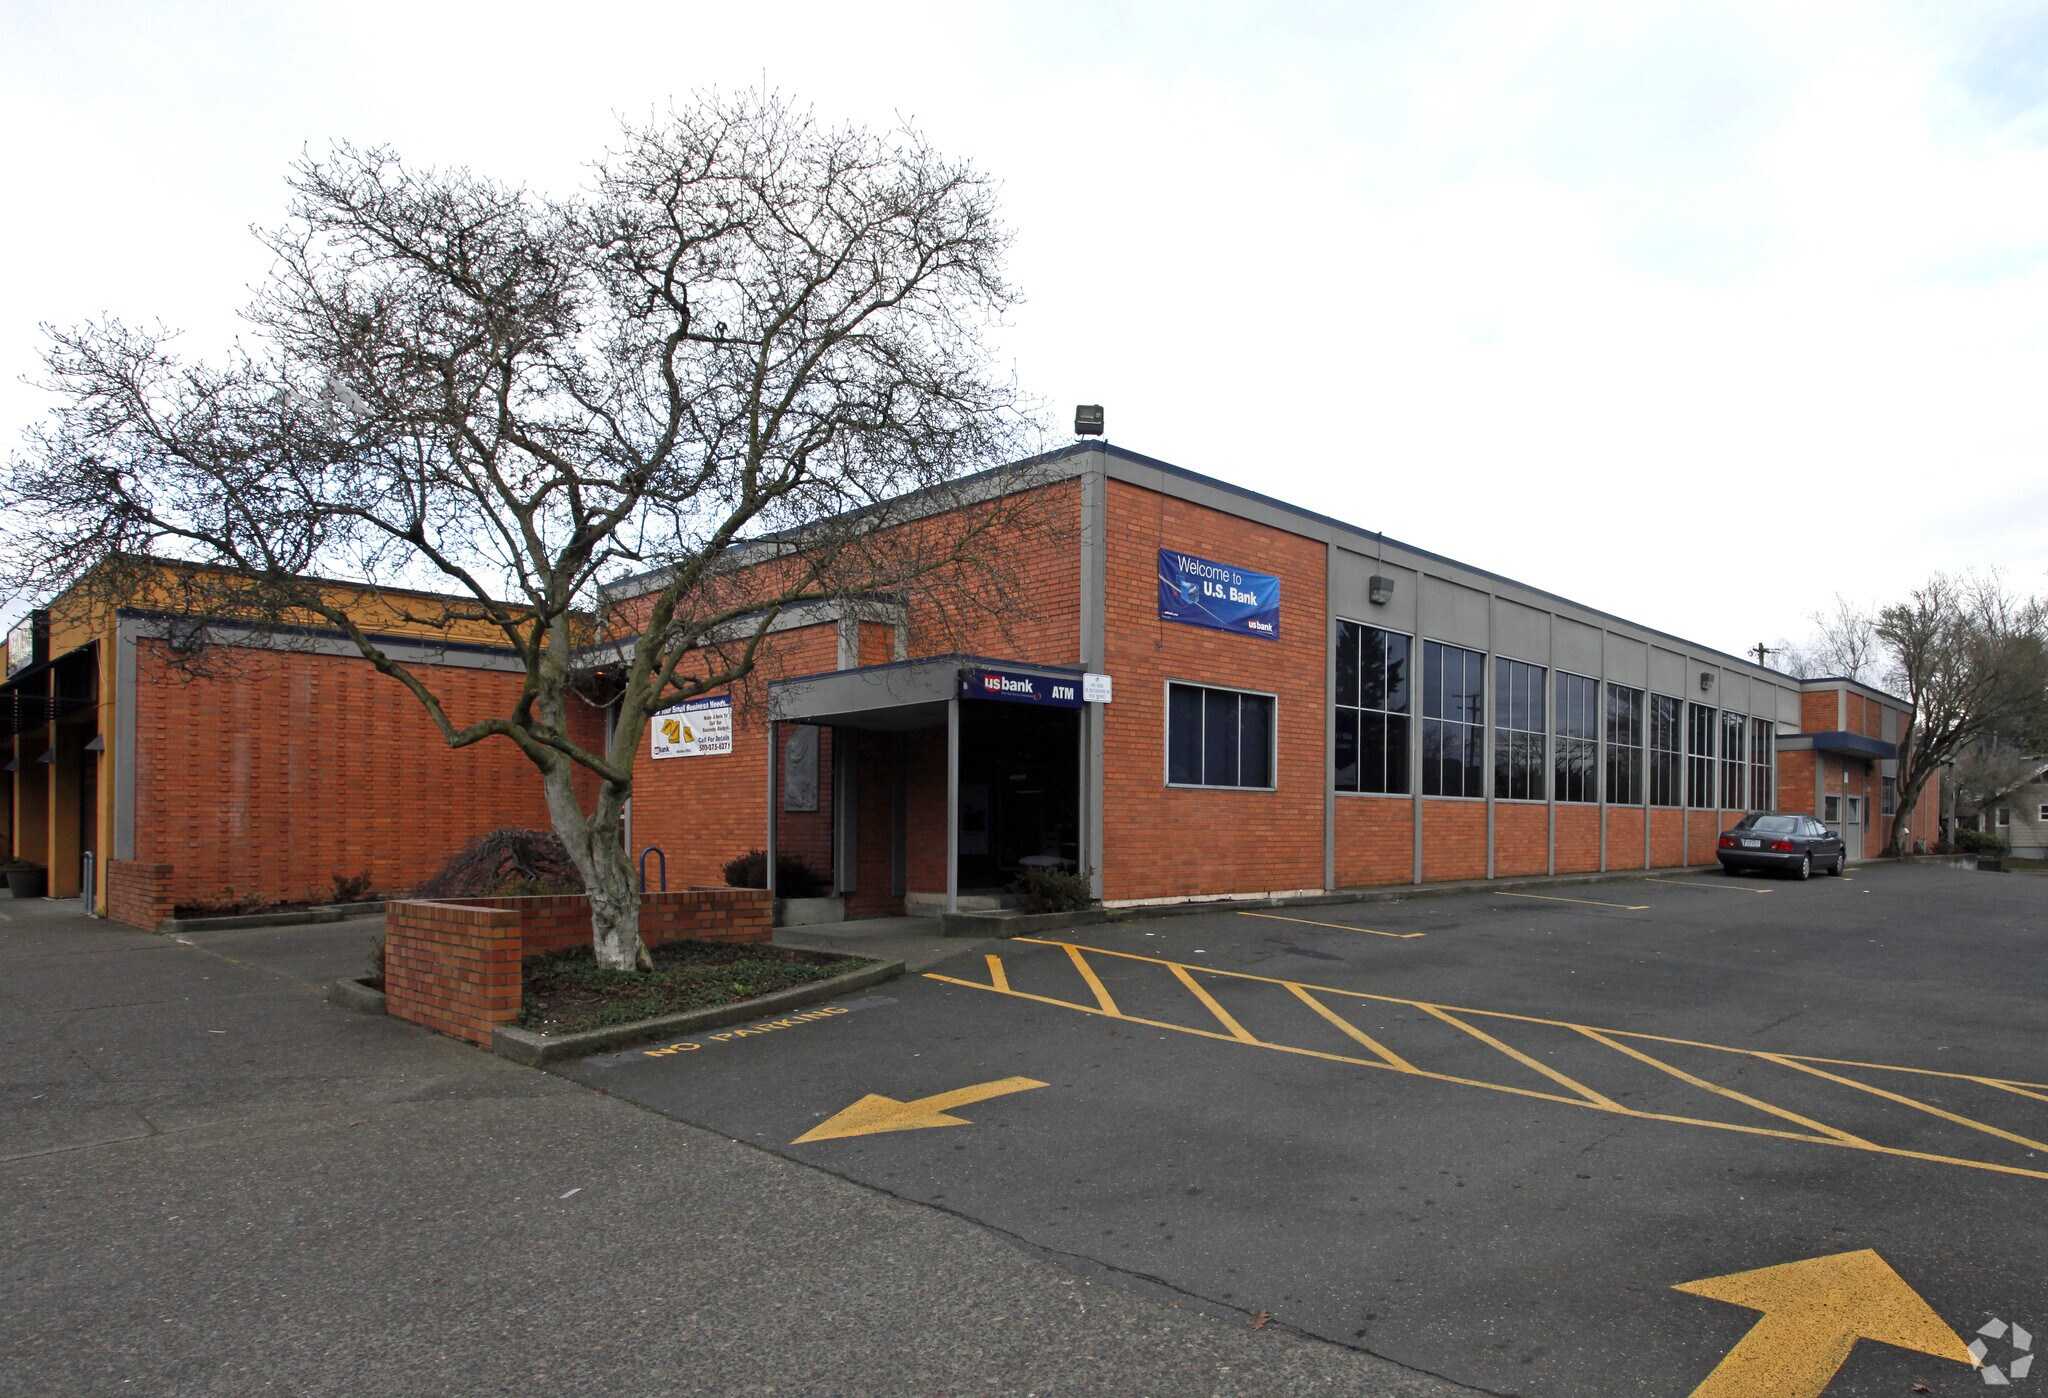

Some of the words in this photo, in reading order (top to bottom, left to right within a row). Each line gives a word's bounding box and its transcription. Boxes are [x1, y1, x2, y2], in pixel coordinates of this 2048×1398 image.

[1177, 555, 1230, 583] Welcome
[1232, 571, 1242, 586] to
[1203, 581, 1227, 600] U.S.
[1229, 586, 1258, 606] Bank
[1248, 620, 1273, 632] usbank
[984, 676, 1034, 694] usbank
[1051, 685, 1075, 701] ATM
[687, 703, 709, 711] Business
[715, 734, 730, 742] Details
[642, 1041, 701, 1057] NO
[708, 1005, 849, 1042] PARKING
